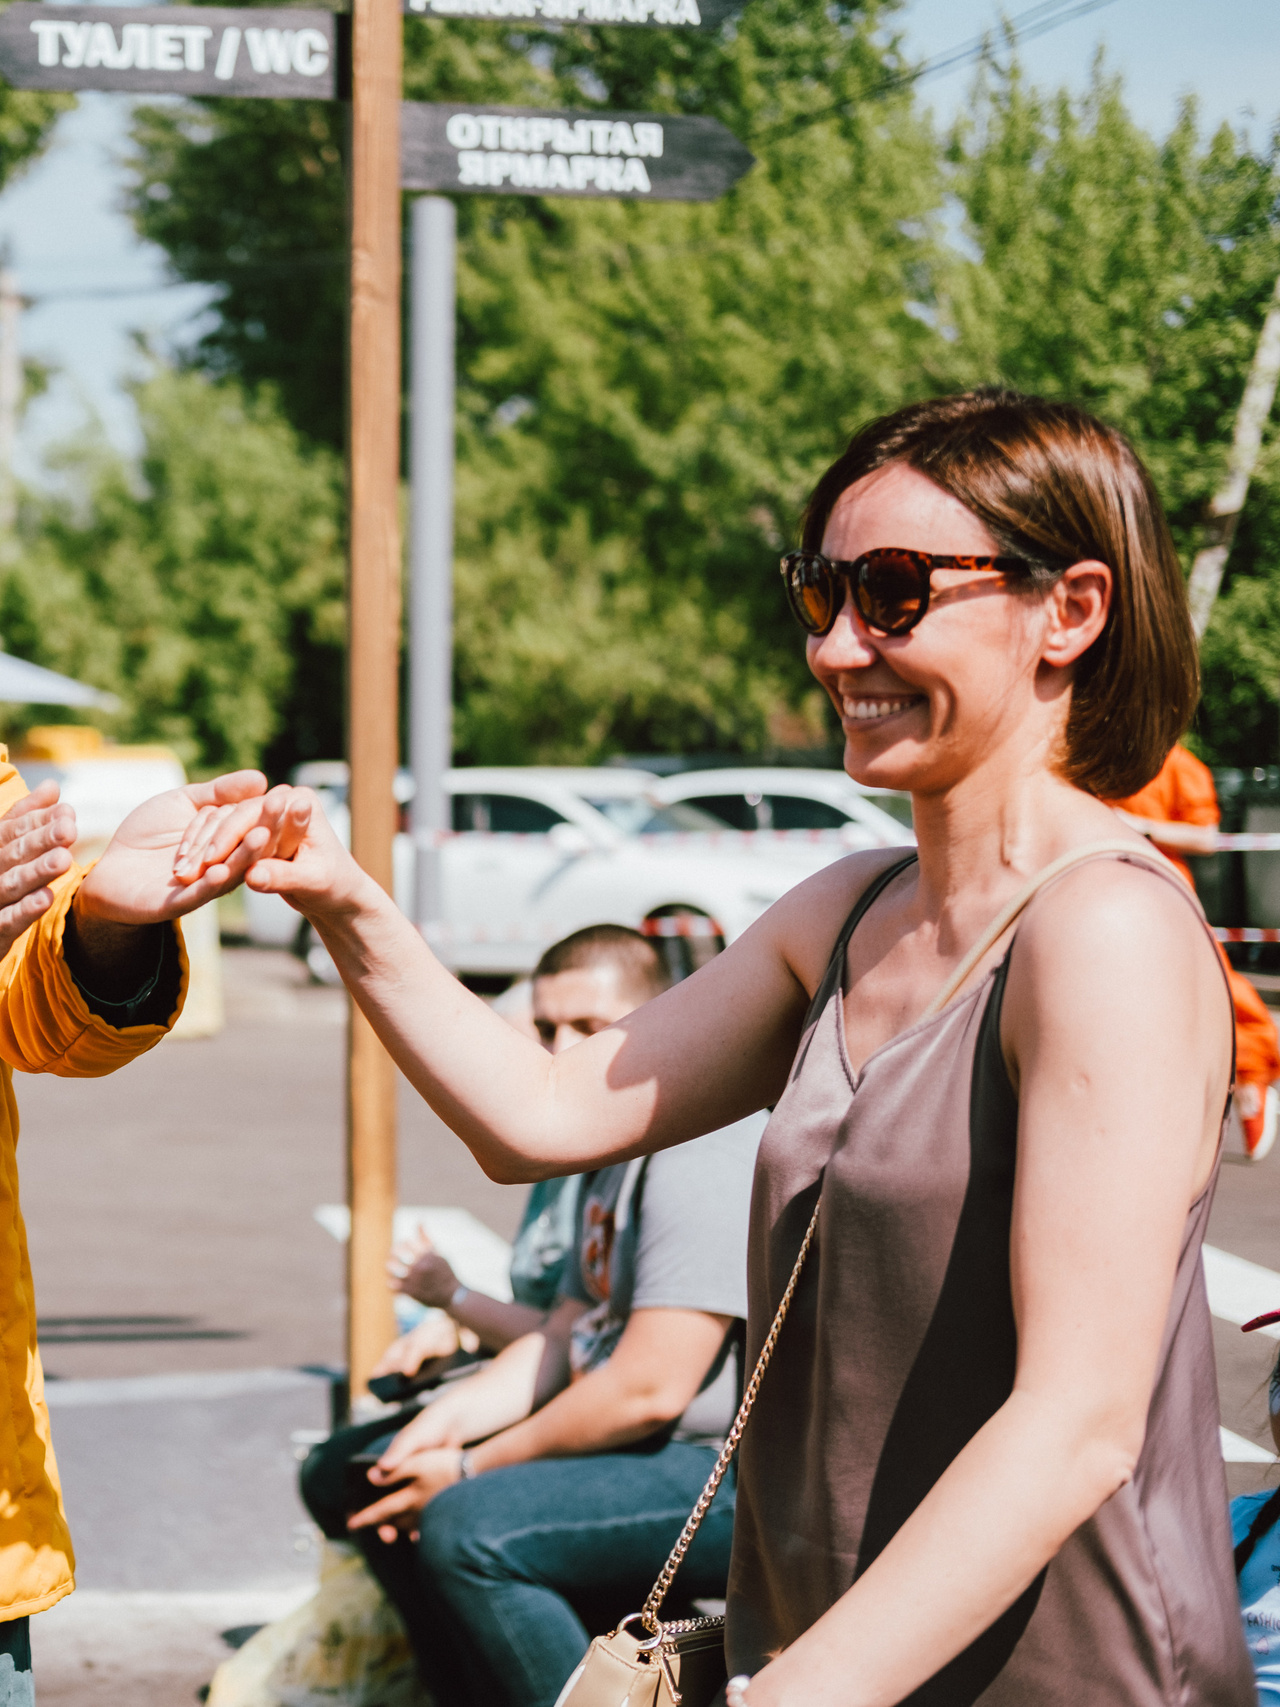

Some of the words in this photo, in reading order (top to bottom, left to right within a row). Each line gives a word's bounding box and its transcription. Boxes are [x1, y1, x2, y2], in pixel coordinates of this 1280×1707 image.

[29, 19, 213, 72] ТУАЛЕТ
[244, 27, 330, 77] WC
[446, 113, 664, 158] ОТКРЫТАЯ
[457, 150, 652, 193] ЯРМАРКА
